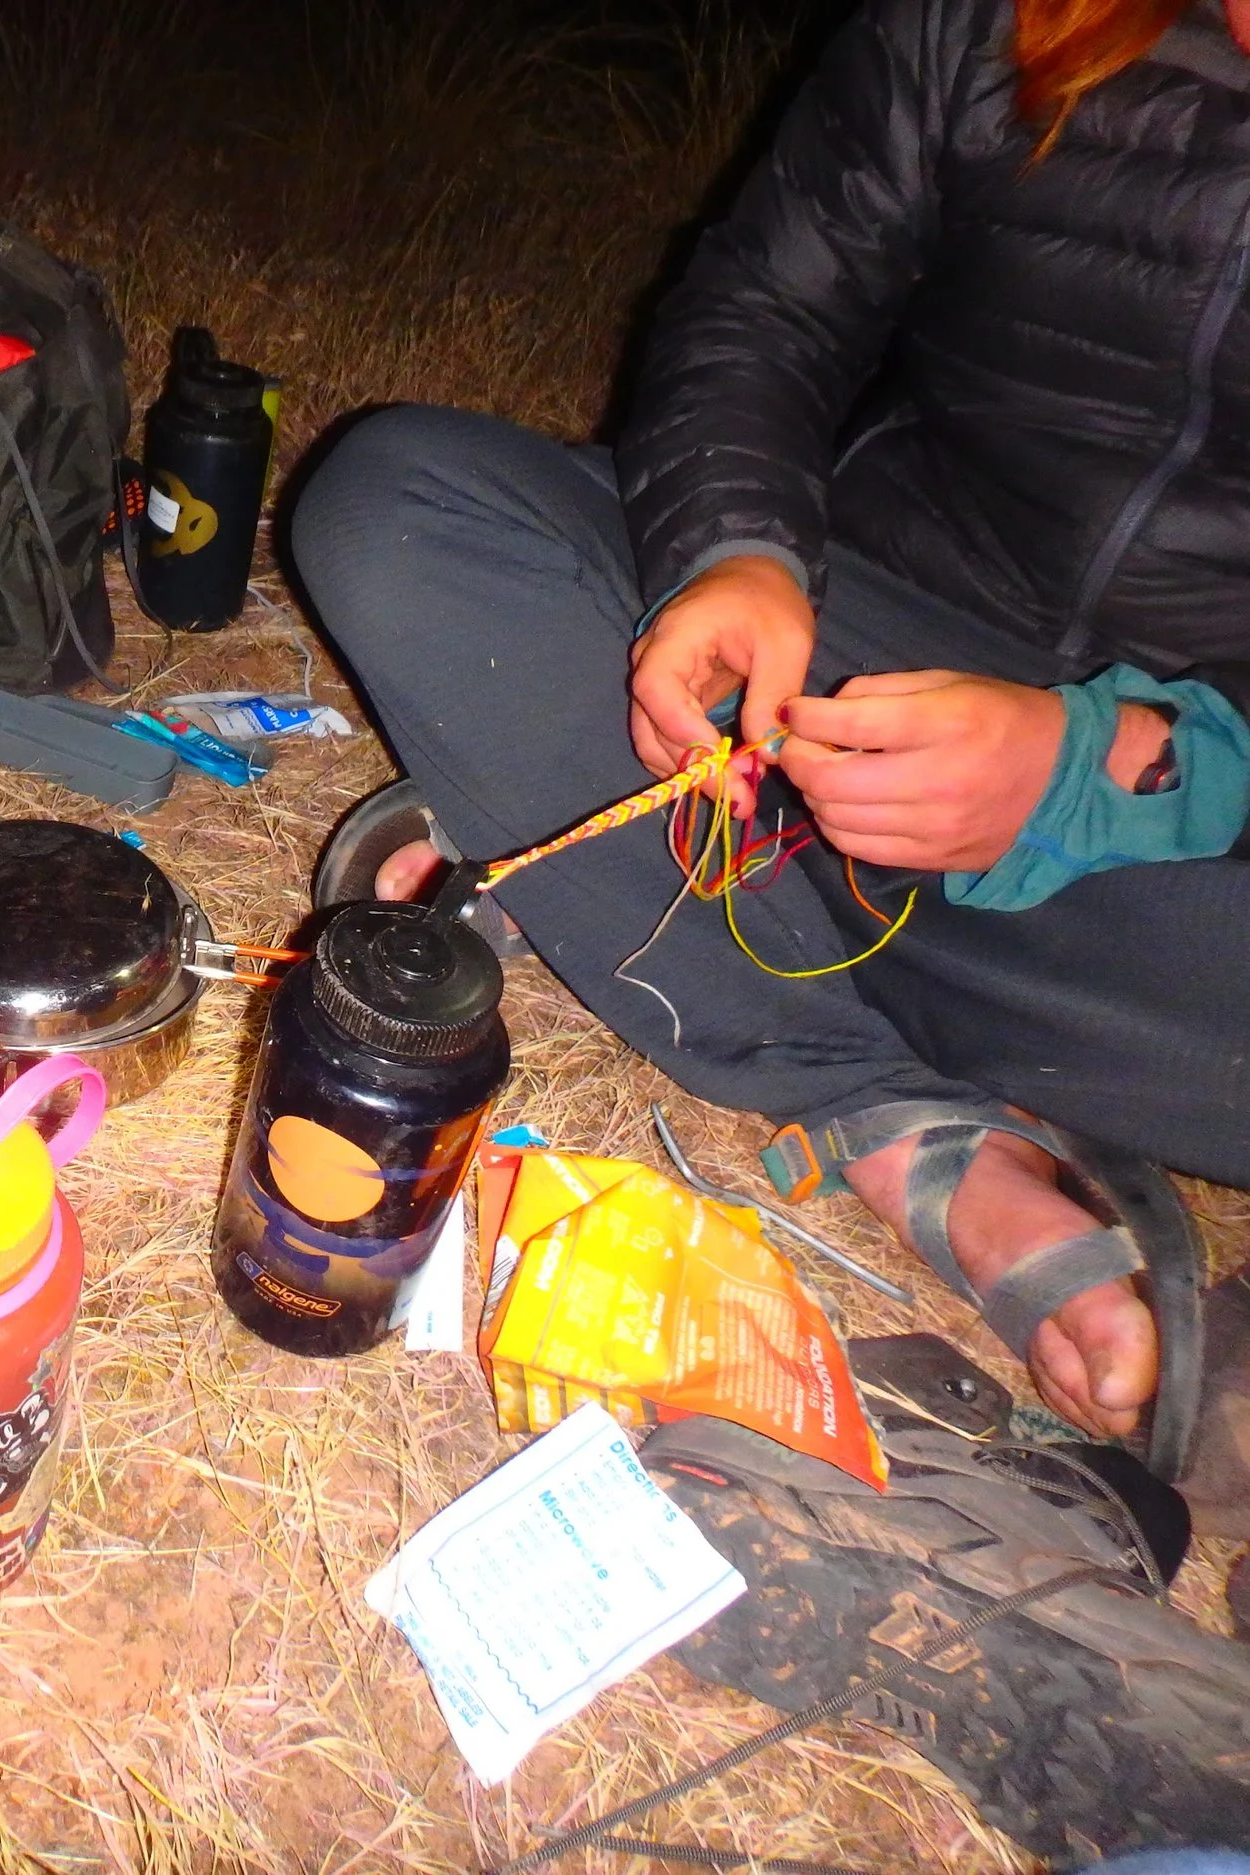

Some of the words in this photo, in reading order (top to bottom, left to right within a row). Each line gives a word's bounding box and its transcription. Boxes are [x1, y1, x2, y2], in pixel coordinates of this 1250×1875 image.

[259, 1276, 329, 1310] nalgene
[808, 1335, 837, 1438] FOUNDATION
[457, 1705, 479, 1730] SALE
